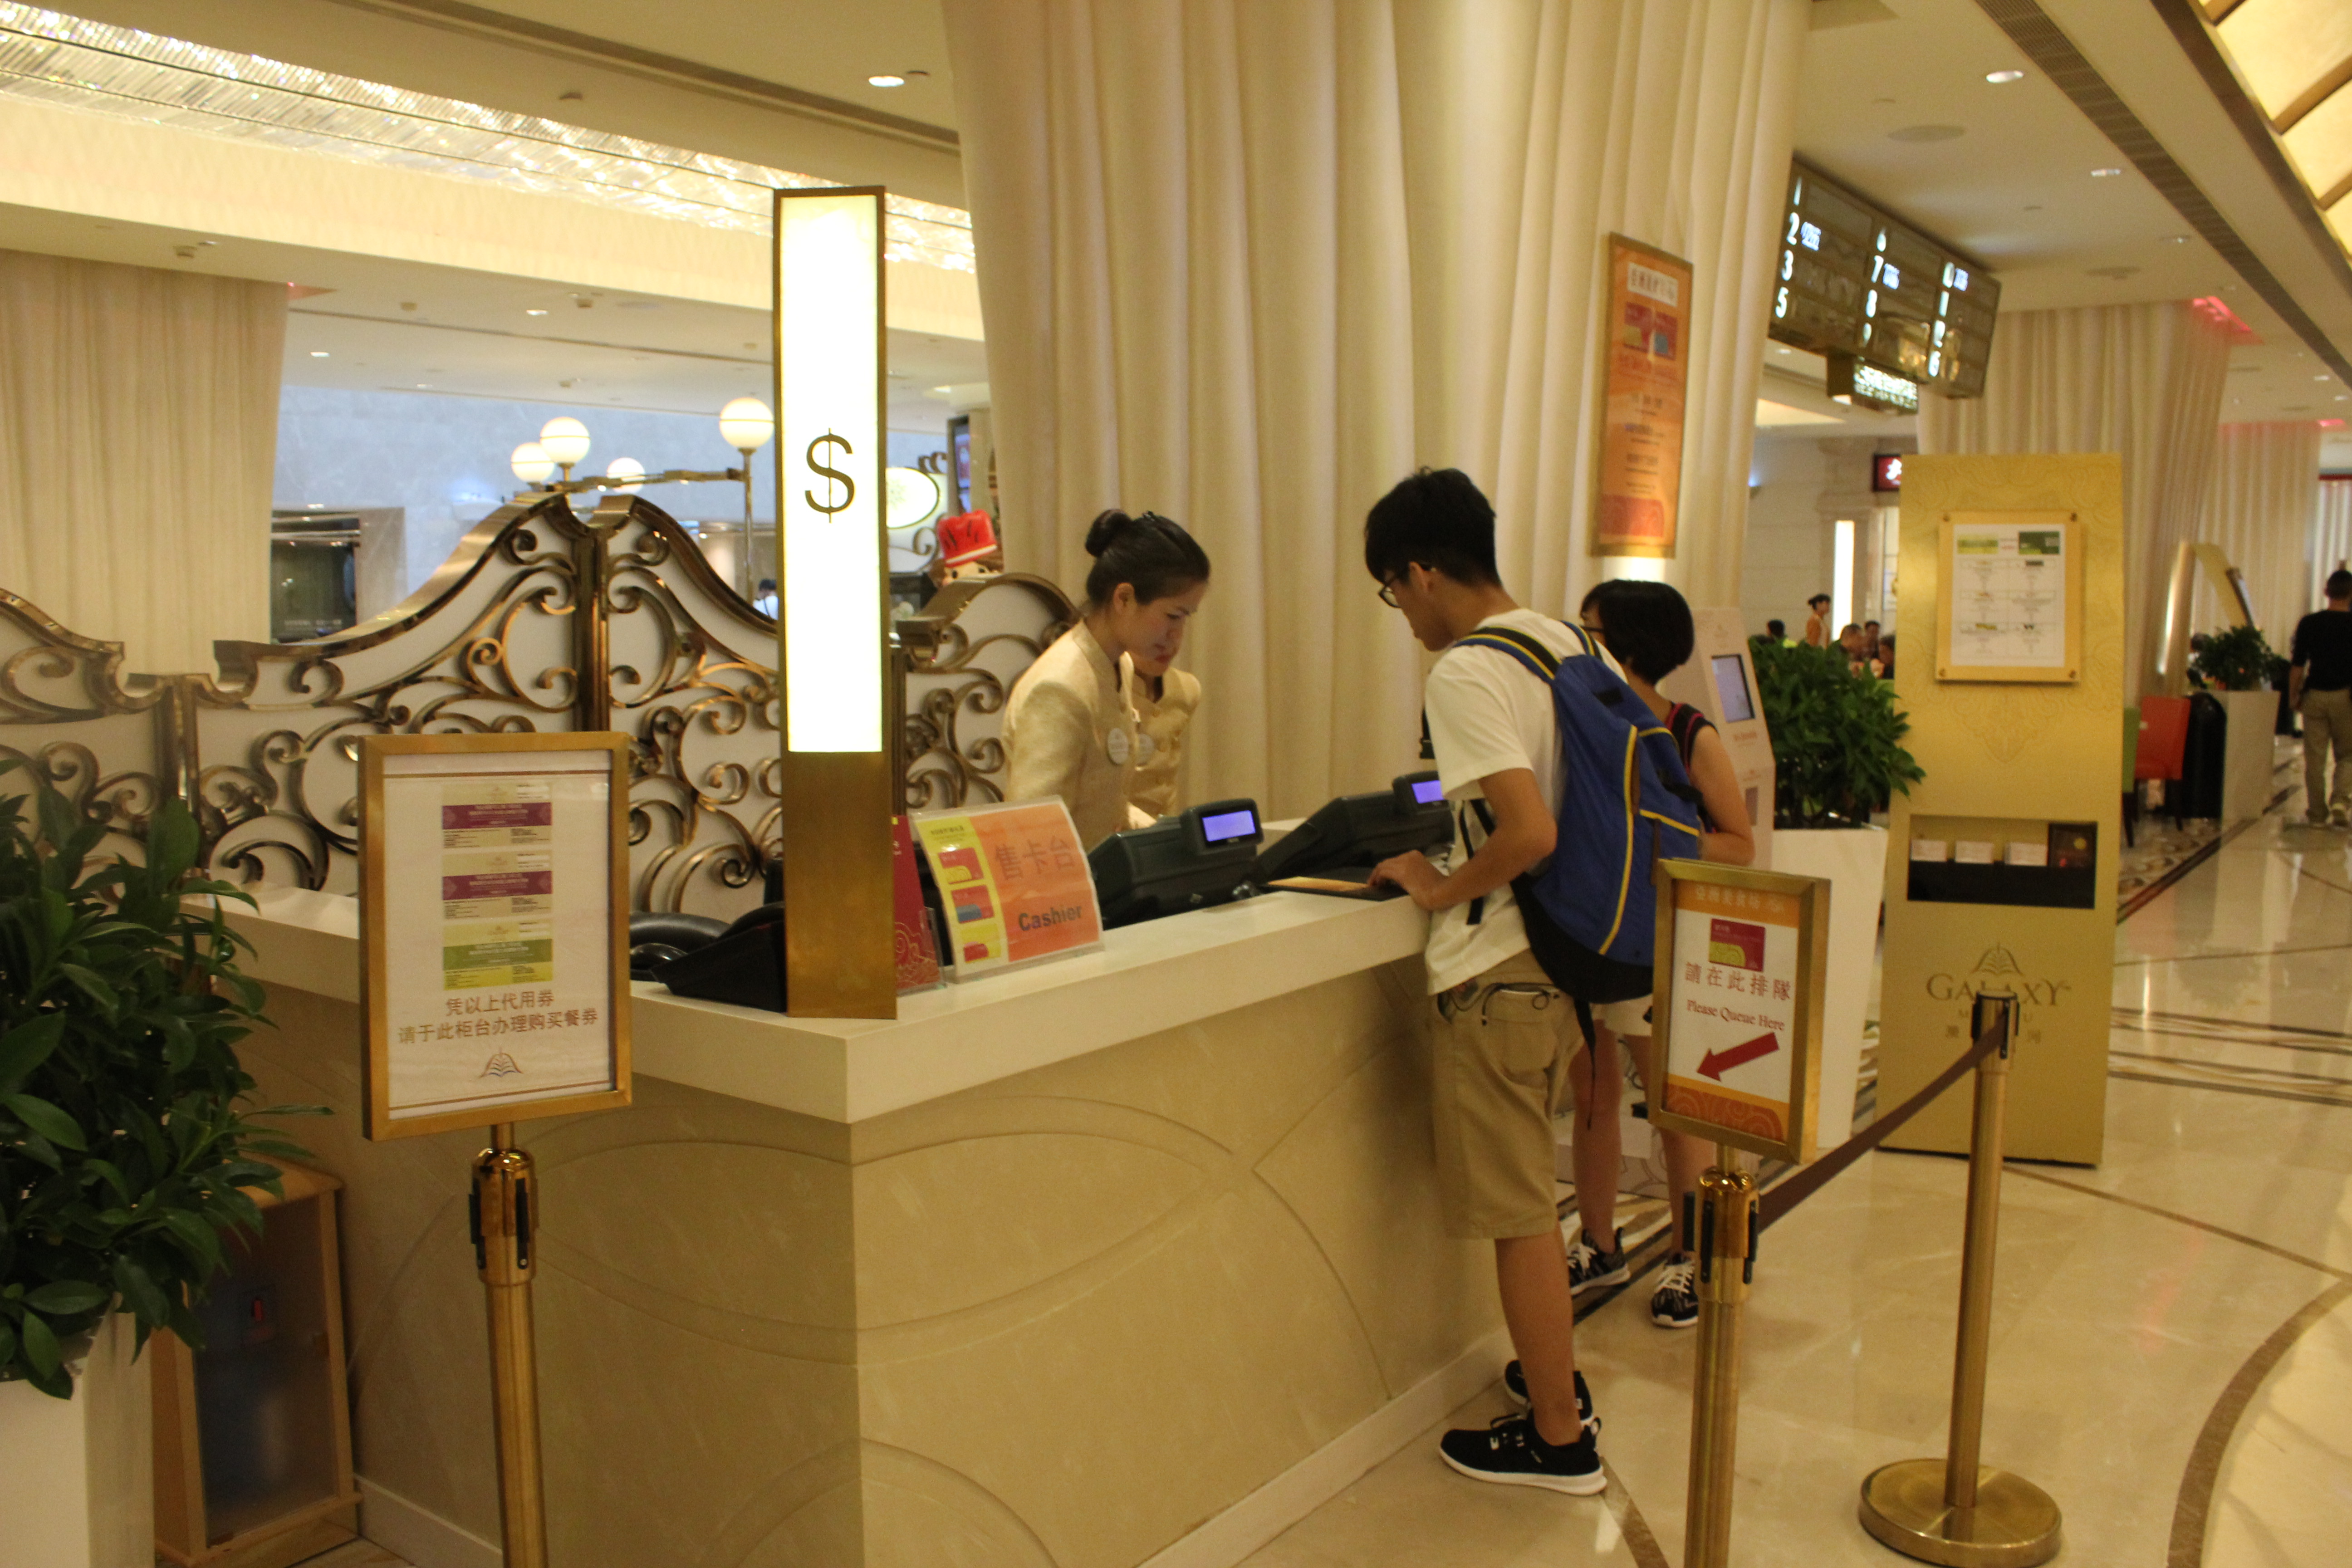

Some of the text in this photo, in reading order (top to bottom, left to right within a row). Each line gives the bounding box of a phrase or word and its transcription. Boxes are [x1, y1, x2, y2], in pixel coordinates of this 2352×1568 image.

[995, 835, 1076, 881] 售卡台
[1018, 905, 1083, 931] Cashier
[1684, 961, 1791, 1000] 請在此排隊
[1927, 973, 2071, 1005] GAXY
[445, 989, 555, 1017] 凭以上代用券
[1686, 999, 1785, 1031] Please Queue Here
